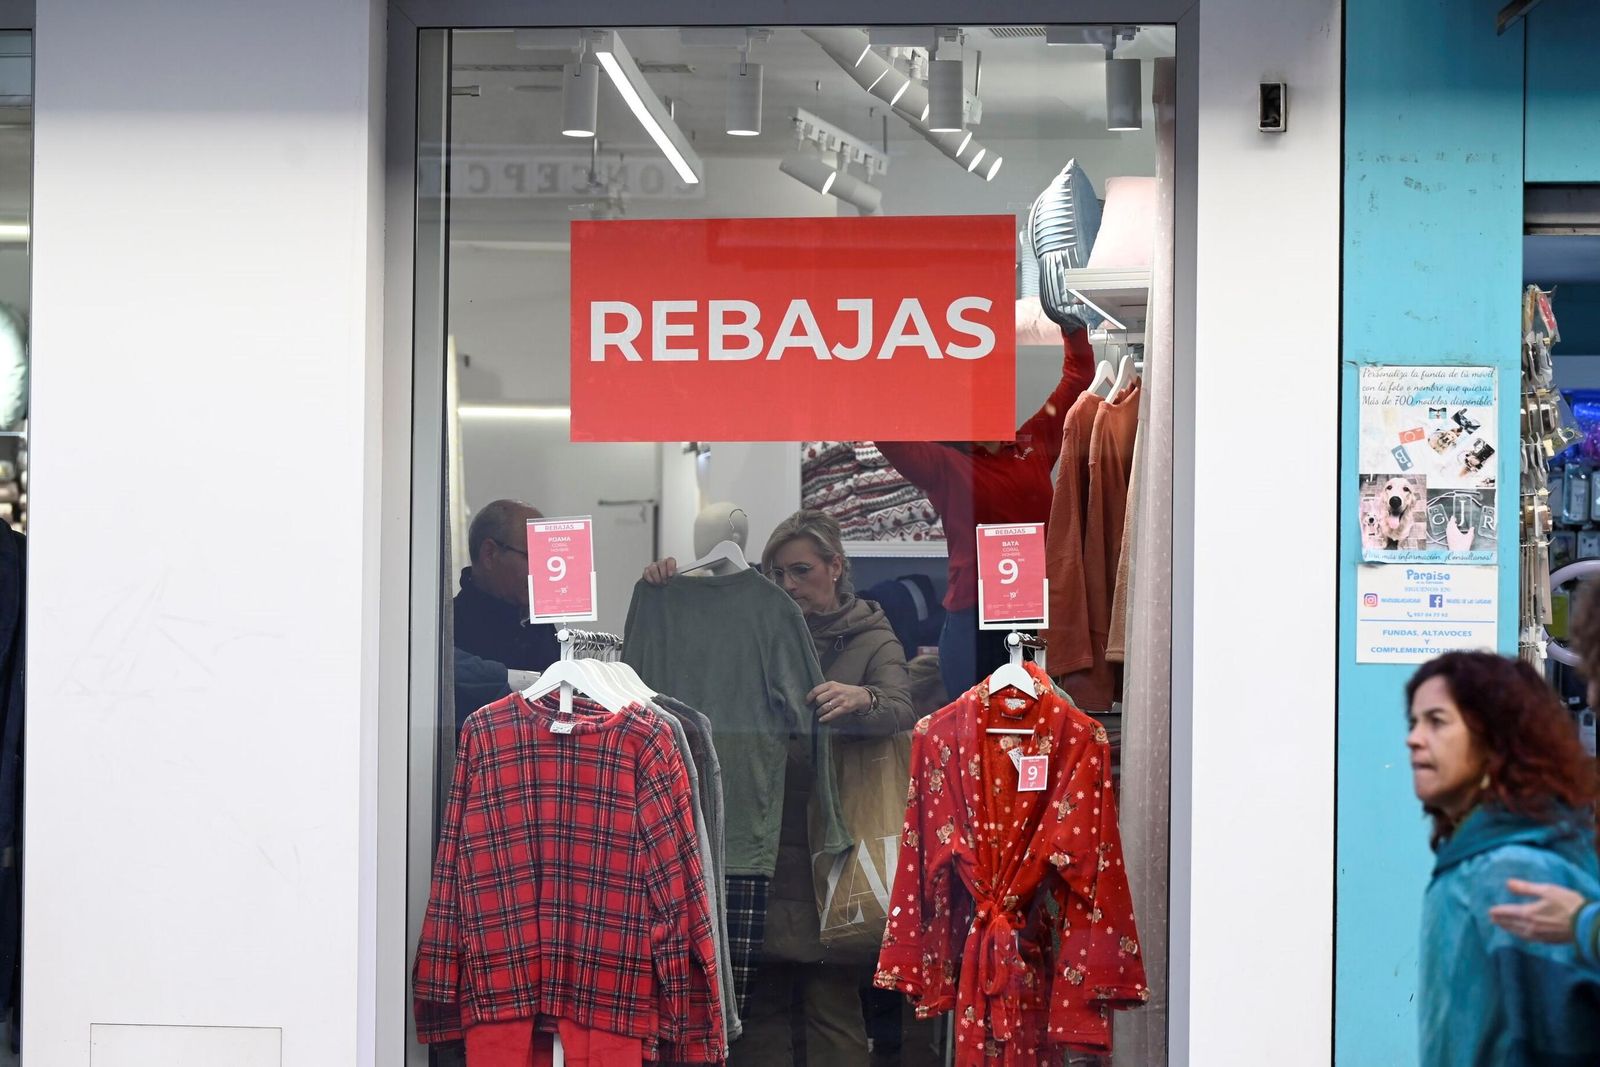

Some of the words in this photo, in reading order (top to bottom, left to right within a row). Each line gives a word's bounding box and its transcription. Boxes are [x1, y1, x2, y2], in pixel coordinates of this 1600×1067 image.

[590, 296, 996, 361] REBAJAS
[1362, 368, 1408, 380] Personaliza
[1410, 368, 1419, 378] la
[1421, 369, 1446, 380] funda
[1449, 368, 1458, 378] de
[1377, 382, 1386, 392] la
[1388, 382, 1404, 394] foto
[1414, 382, 1443, 392] nombre
[1445, 384, 1460, 394] que
[1381, 395, 1391, 406] de
[1394, 395, 1414, 406] 700
[1415, 396, 1448, 406] modelos
[547, 556, 567, 582] 9
[998, 558, 1019, 585] 9
[1028, 766, 1038, 780] 9
